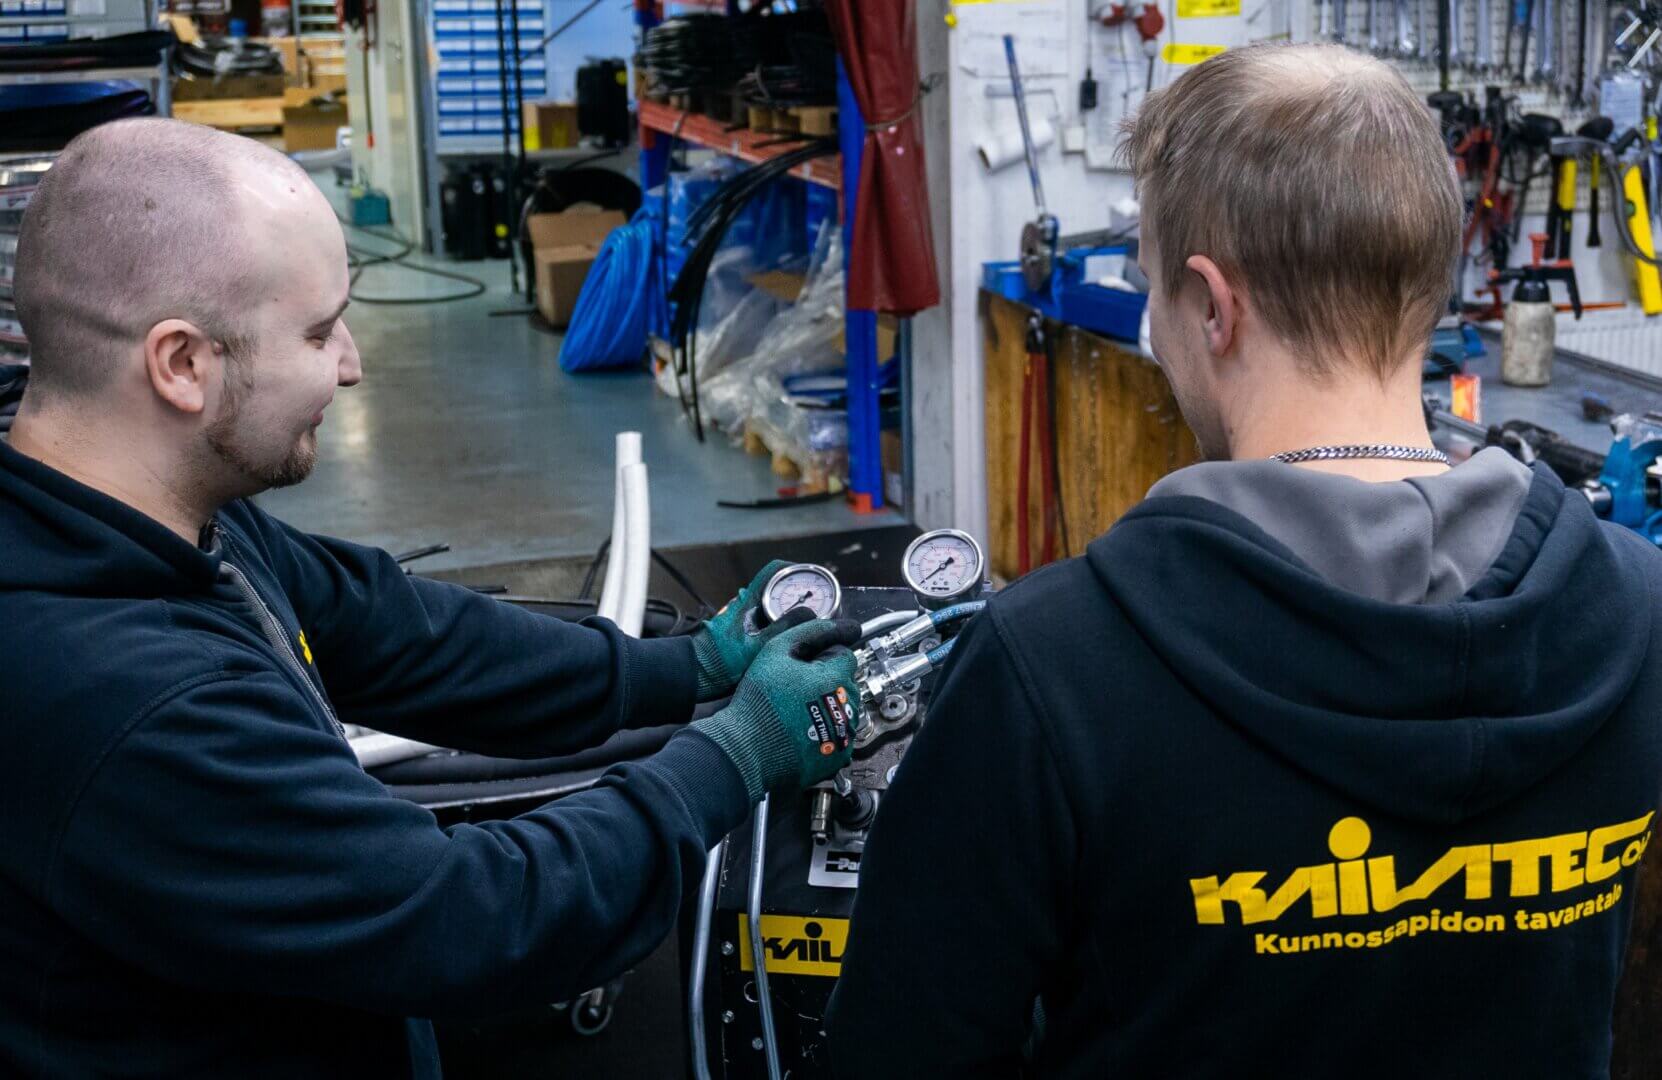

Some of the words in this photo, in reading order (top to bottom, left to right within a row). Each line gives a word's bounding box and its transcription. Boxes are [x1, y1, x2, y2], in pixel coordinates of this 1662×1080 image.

[810, 705, 824, 723] CUT
[1254, 908, 1506, 955] Kunnossapidon
[1514, 882, 1623, 932] tavaratalo
